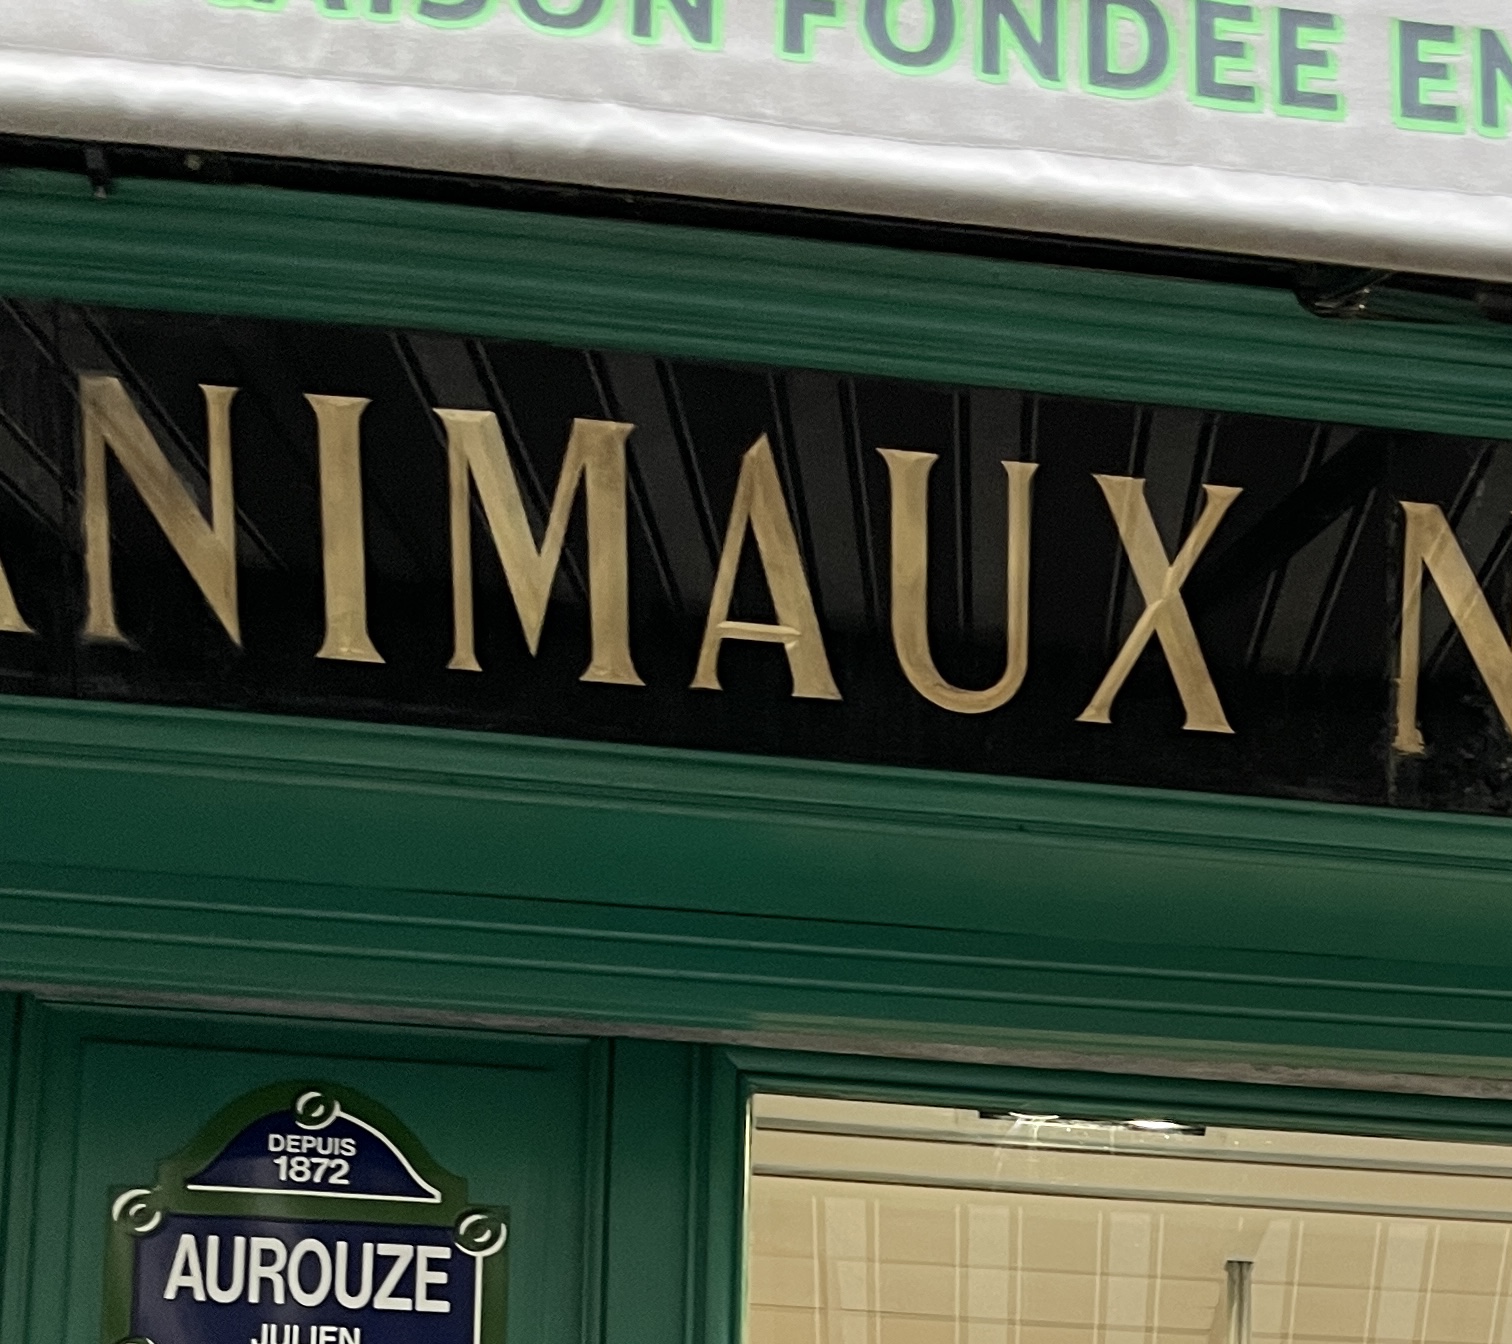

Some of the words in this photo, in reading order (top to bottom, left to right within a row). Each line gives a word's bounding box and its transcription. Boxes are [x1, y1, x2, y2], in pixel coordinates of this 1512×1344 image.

[776, 0, 1344, 120] FONDEE
[0, 370, 1244, 737] NIMAUX
[267, 1133, 357, 1158] DEPUIS
[272, 1156, 351, 1185] 1872
[162, 1232, 452, 1314] AUROUZE
